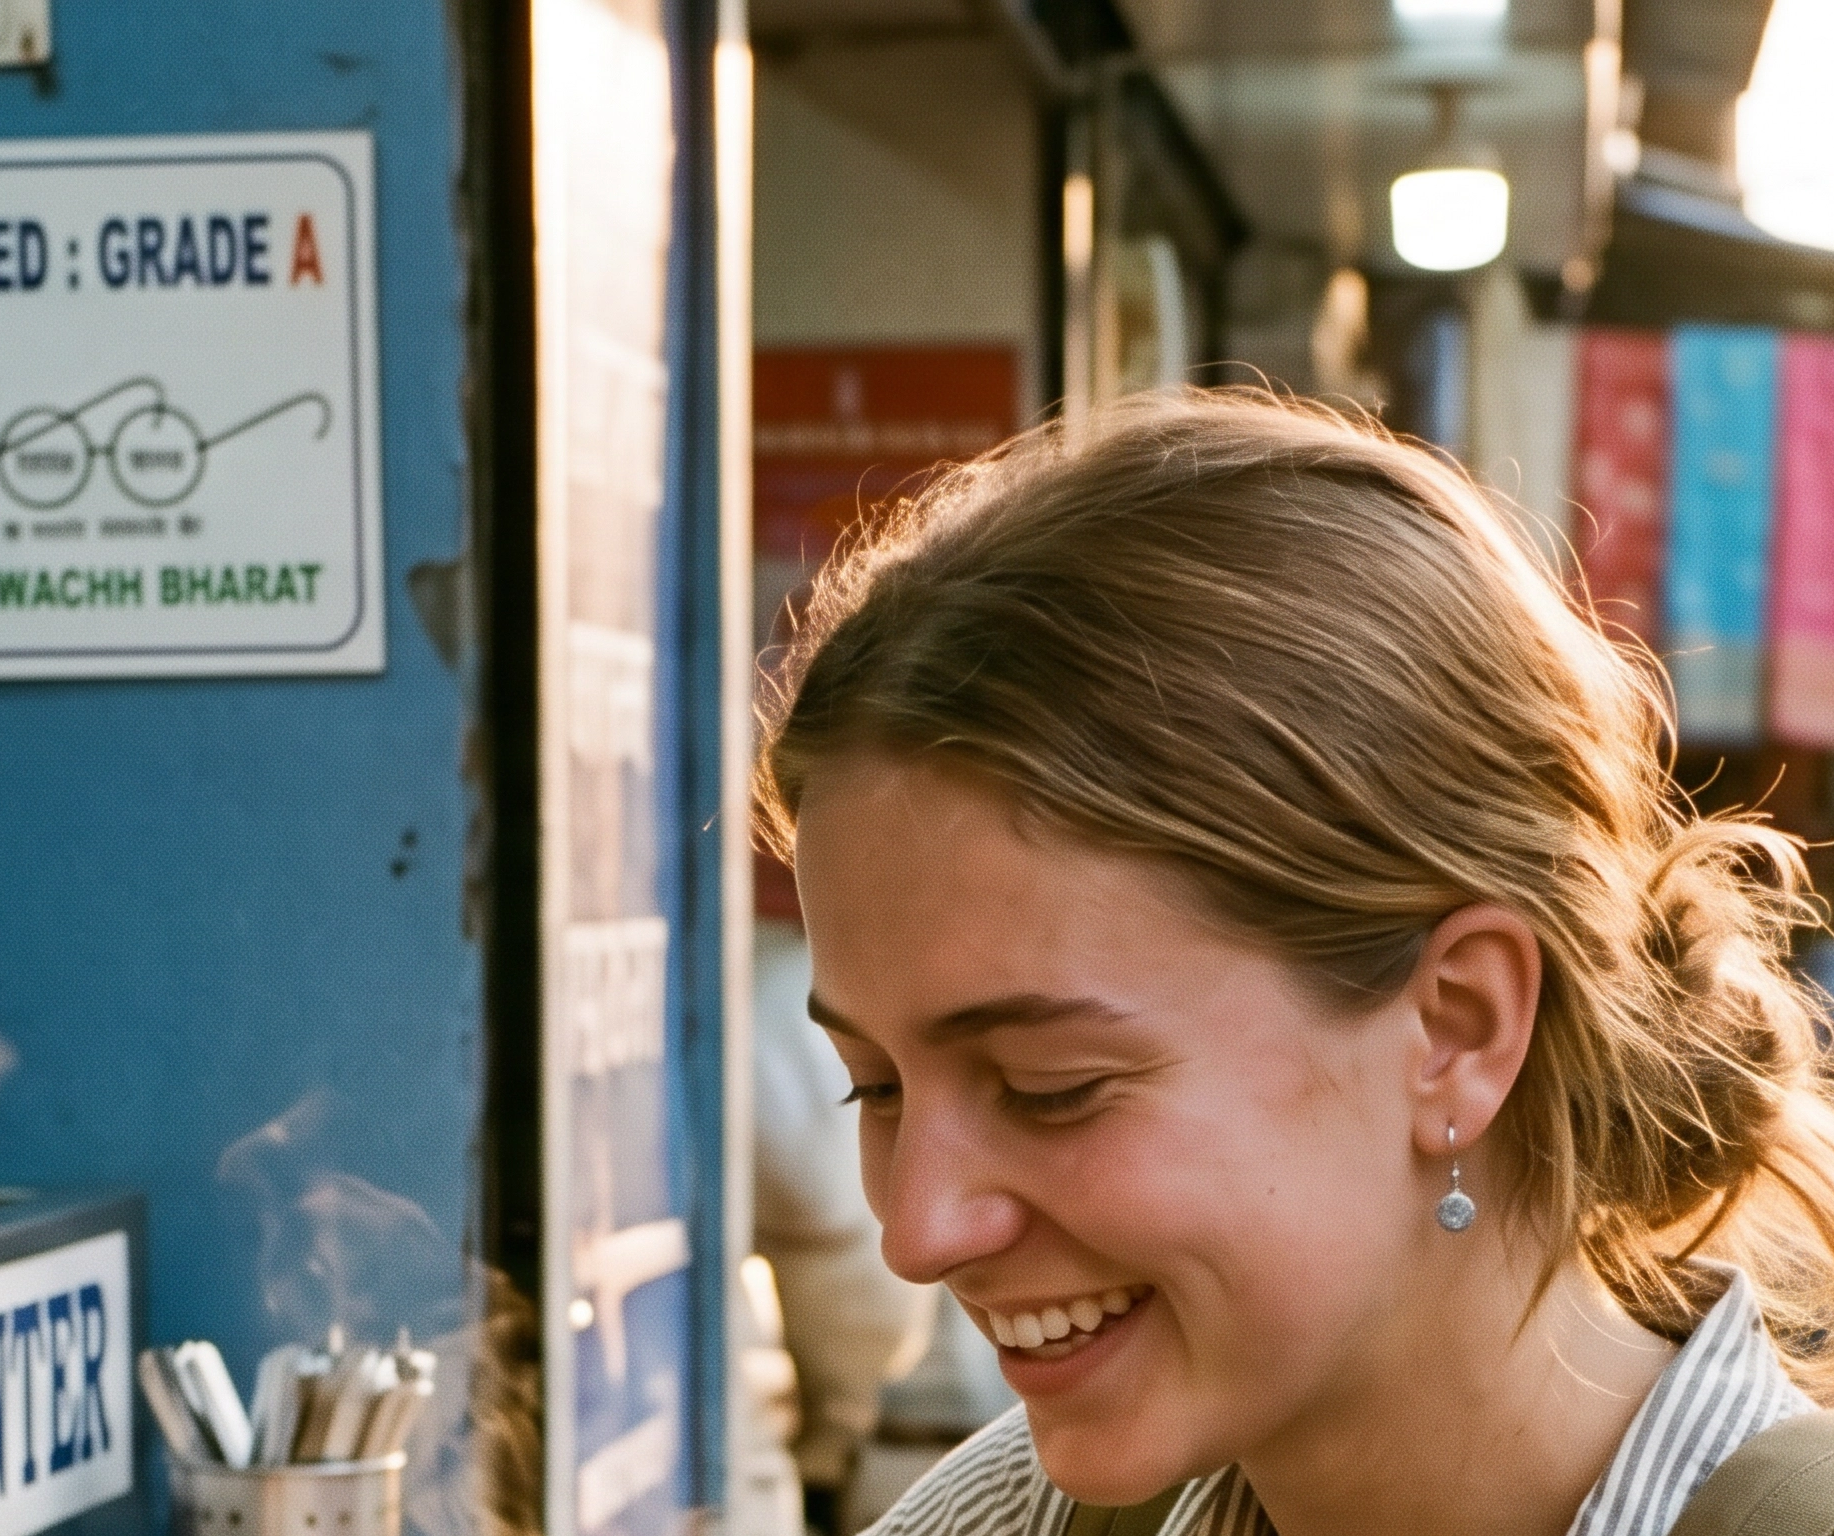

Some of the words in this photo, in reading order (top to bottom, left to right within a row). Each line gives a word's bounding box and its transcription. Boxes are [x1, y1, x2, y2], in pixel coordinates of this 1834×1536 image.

[98, 213, 273, 291] GRADE
[289, 212, 324, 285] A
[158, 562, 324, 607] BHARAT
